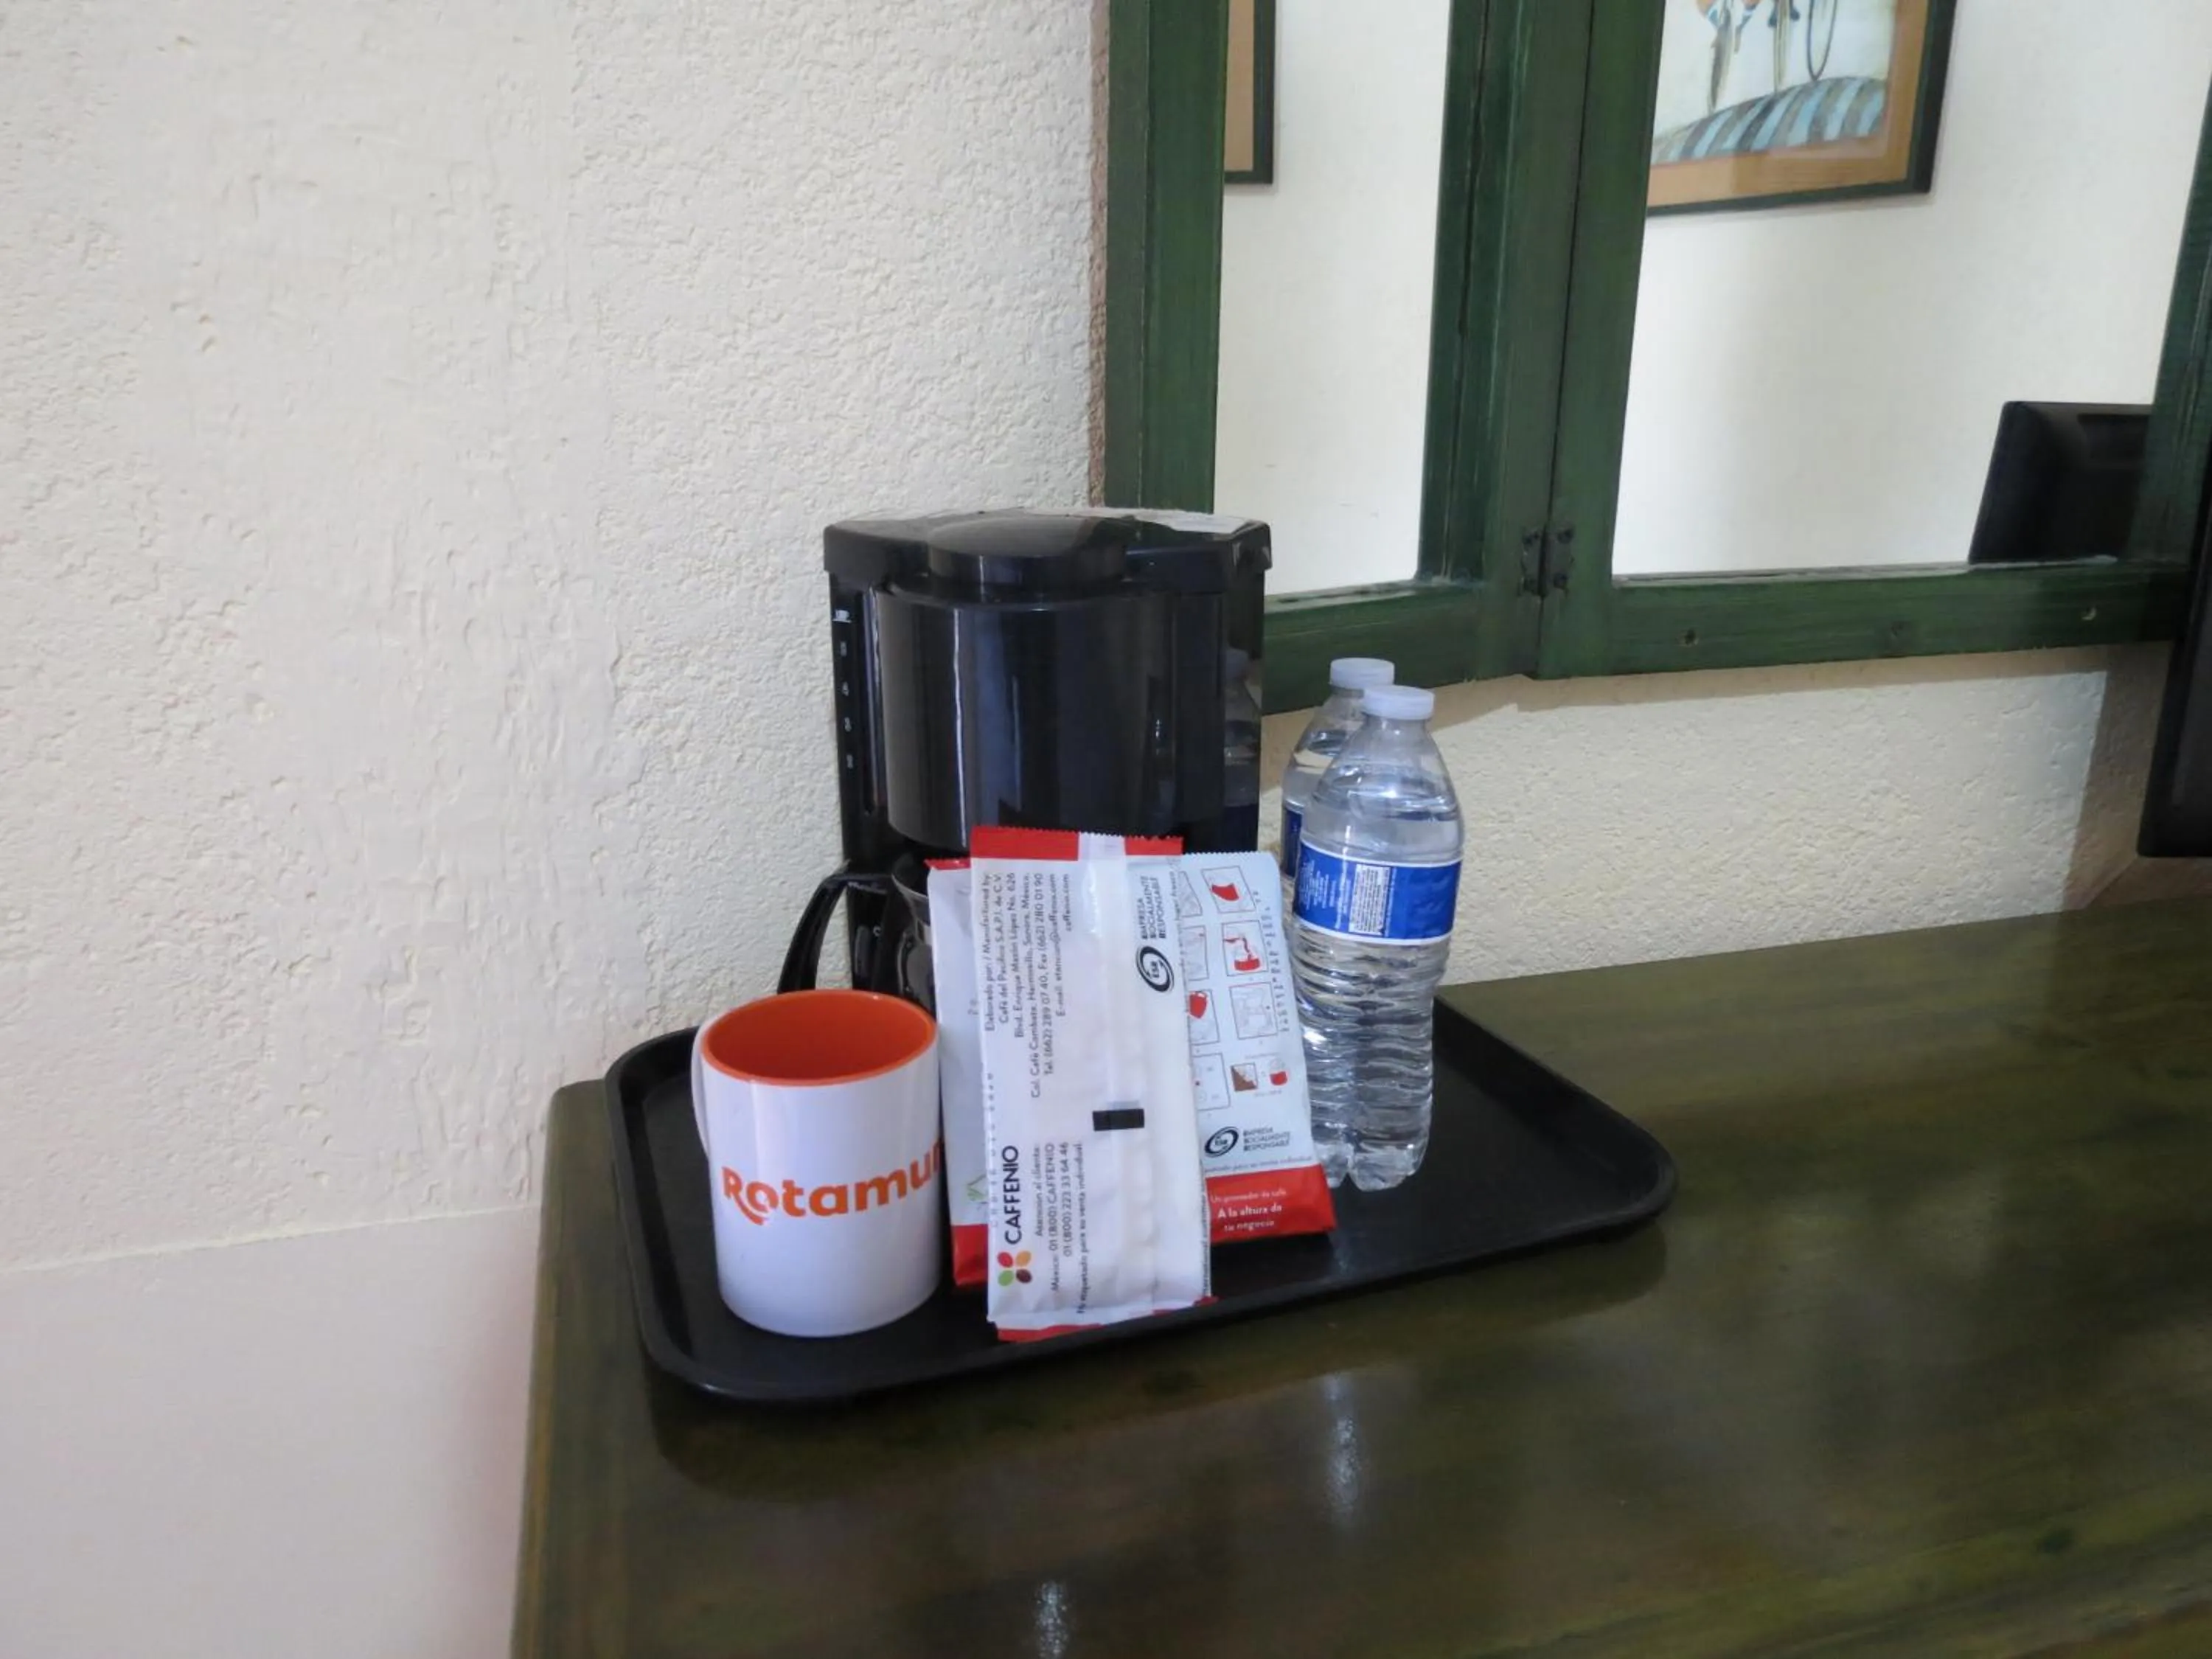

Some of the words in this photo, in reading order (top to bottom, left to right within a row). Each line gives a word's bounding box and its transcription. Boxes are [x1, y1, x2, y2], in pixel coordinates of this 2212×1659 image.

[1006, 872, 1016, 891] 626
[1034, 873, 1044, 886] 90
[992, 895, 1002, 907] de
[1034, 889, 1044, 900] 01
[1141, 875, 1158, 939] SOCIALMENTE
[1150, 877, 1166, 939] RESPONSABLE
[1137, 898, 1149, 940] EMPRESA
[1034, 925, 1047, 951] (662)
[997, 984, 1007, 998] del
[1012, 975, 1025, 1011] Enrique
[1040, 992, 1051, 1004] 07
[984, 985, 995, 1032] Elaborado
[1042, 1029, 1053, 1057] (662)
[1044, 1143, 1057, 1204] CAFFENIO
[1060, 1175, 1071, 1189] 33
[1001, 1145, 1022, 1245] CAFFENIO
[1077, 1192, 1087, 1217] venta
[1047, 1206, 1058, 1237] (800)
[1217, 1208, 1226, 1220] A
[1228, 1207, 1239, 1218] la
[1239, 1203, 1269, 1217] altura
[1062, 1211, 1073, 1243] (800)
[1079, 1219, 1087, 1230] su
[1236, 1220, 1276, 1233] negocio
[1048, 1239, 1059, 1251] 01
[1062, 1245, 1073, 1257] 01
[1079, 1232, 1091, 1253] para
